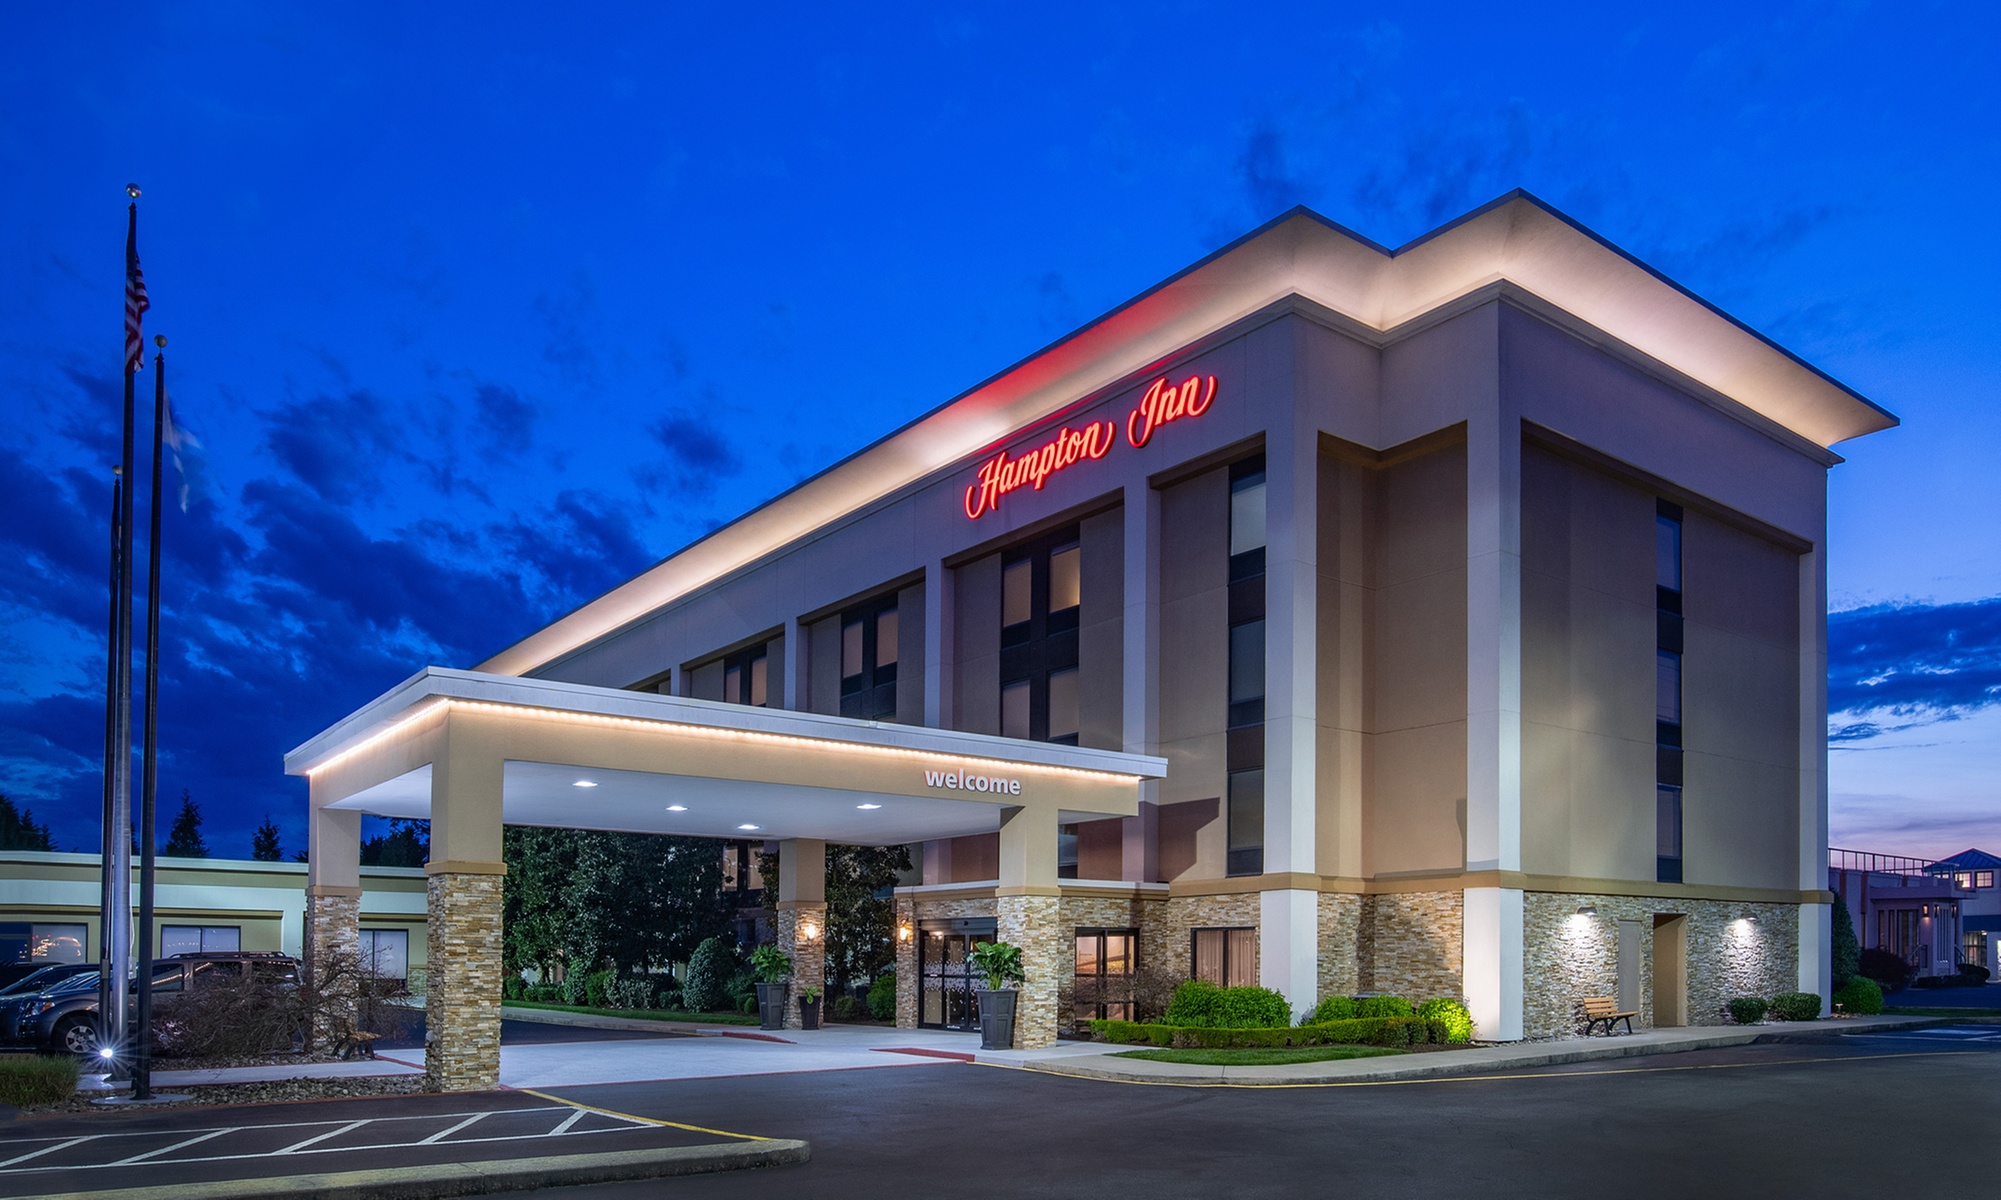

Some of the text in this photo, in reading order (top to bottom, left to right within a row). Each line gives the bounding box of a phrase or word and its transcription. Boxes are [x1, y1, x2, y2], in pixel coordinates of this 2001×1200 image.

[965, 375, 1218, 519] Hampton Inn
[924, 768, 1021, 795] welcome
